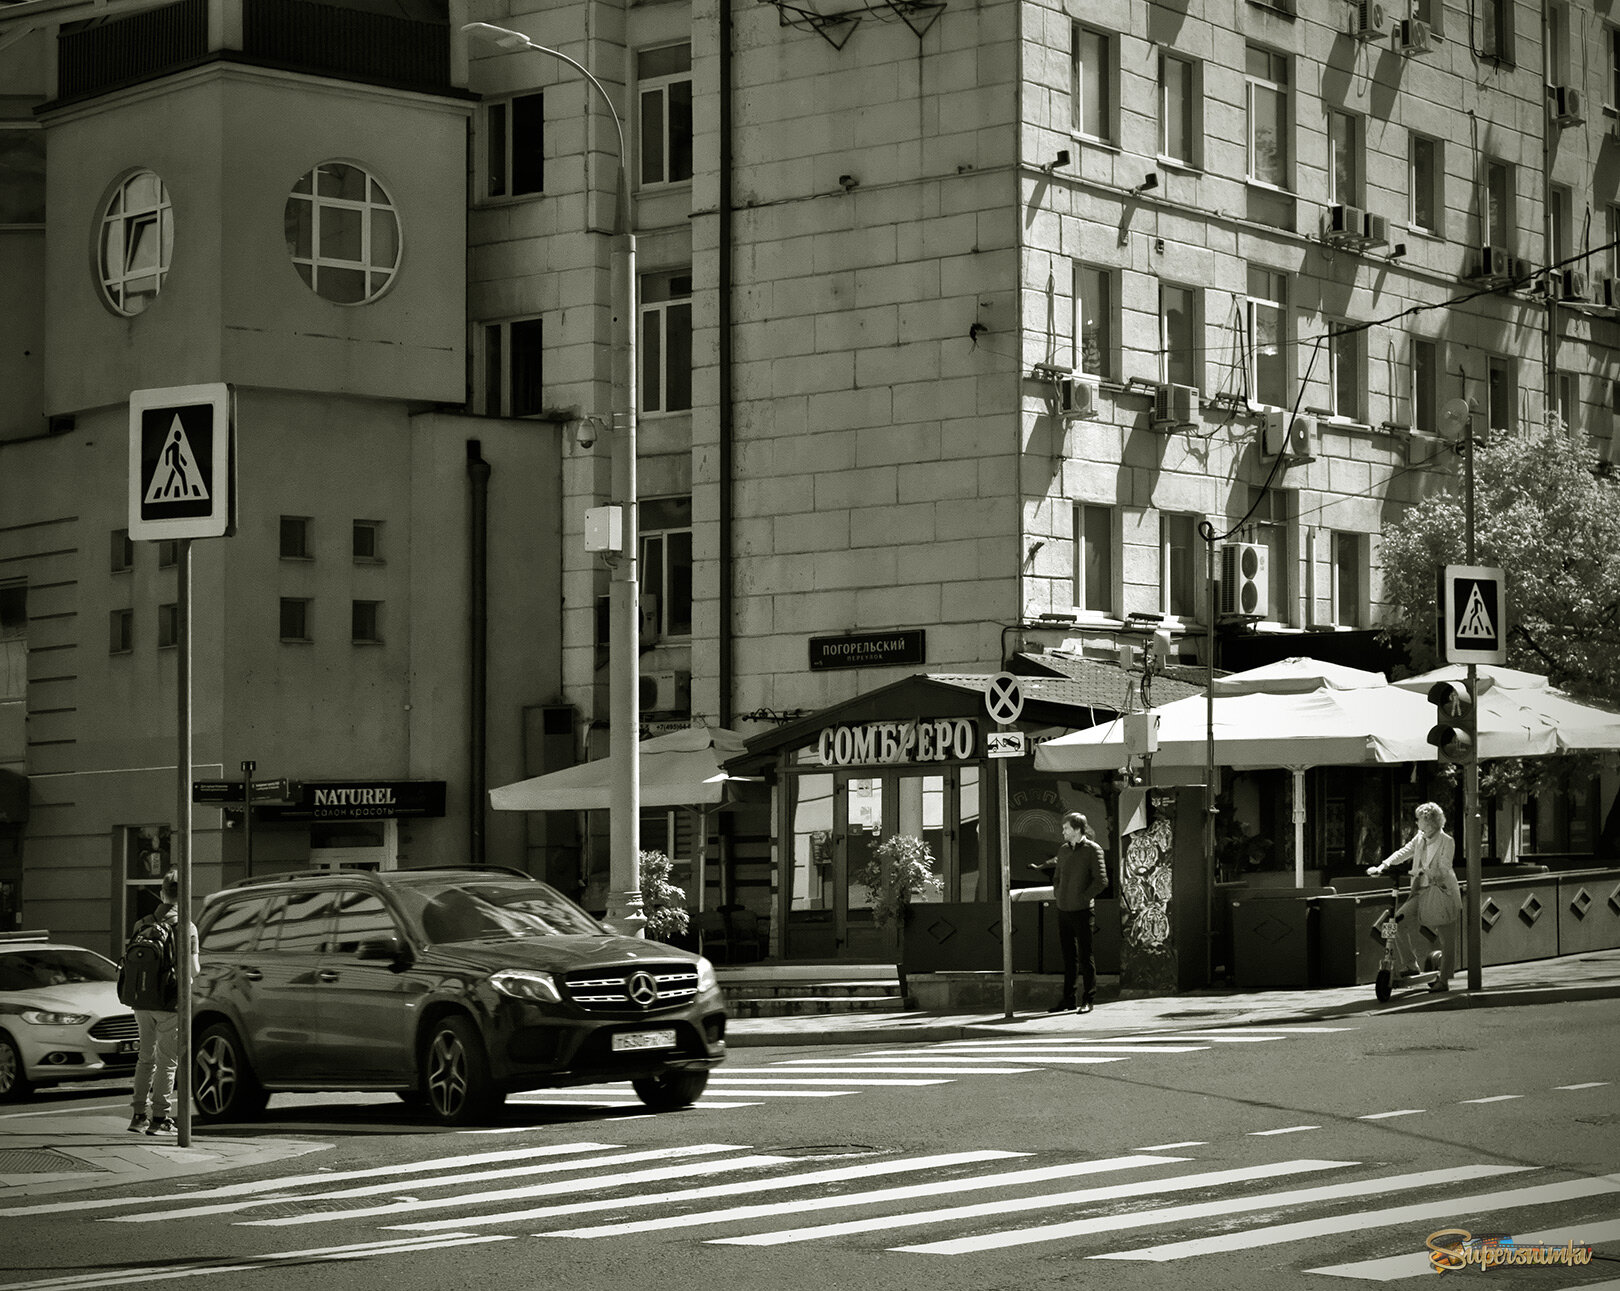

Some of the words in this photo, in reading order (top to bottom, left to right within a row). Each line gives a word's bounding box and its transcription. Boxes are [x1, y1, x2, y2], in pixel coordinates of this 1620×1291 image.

[822, 638, 905, 656] ПОГОРЕЛЬСКИЙ
[846, 654, 883, 662] ПЕРЕУЛОК
[818, 719, 975, 766] СОМБРЕРО
[313, 788, 396, 806] NATUREL
[314, 808, 347, 817] салон
[350, 807, 395, 818] красоты
